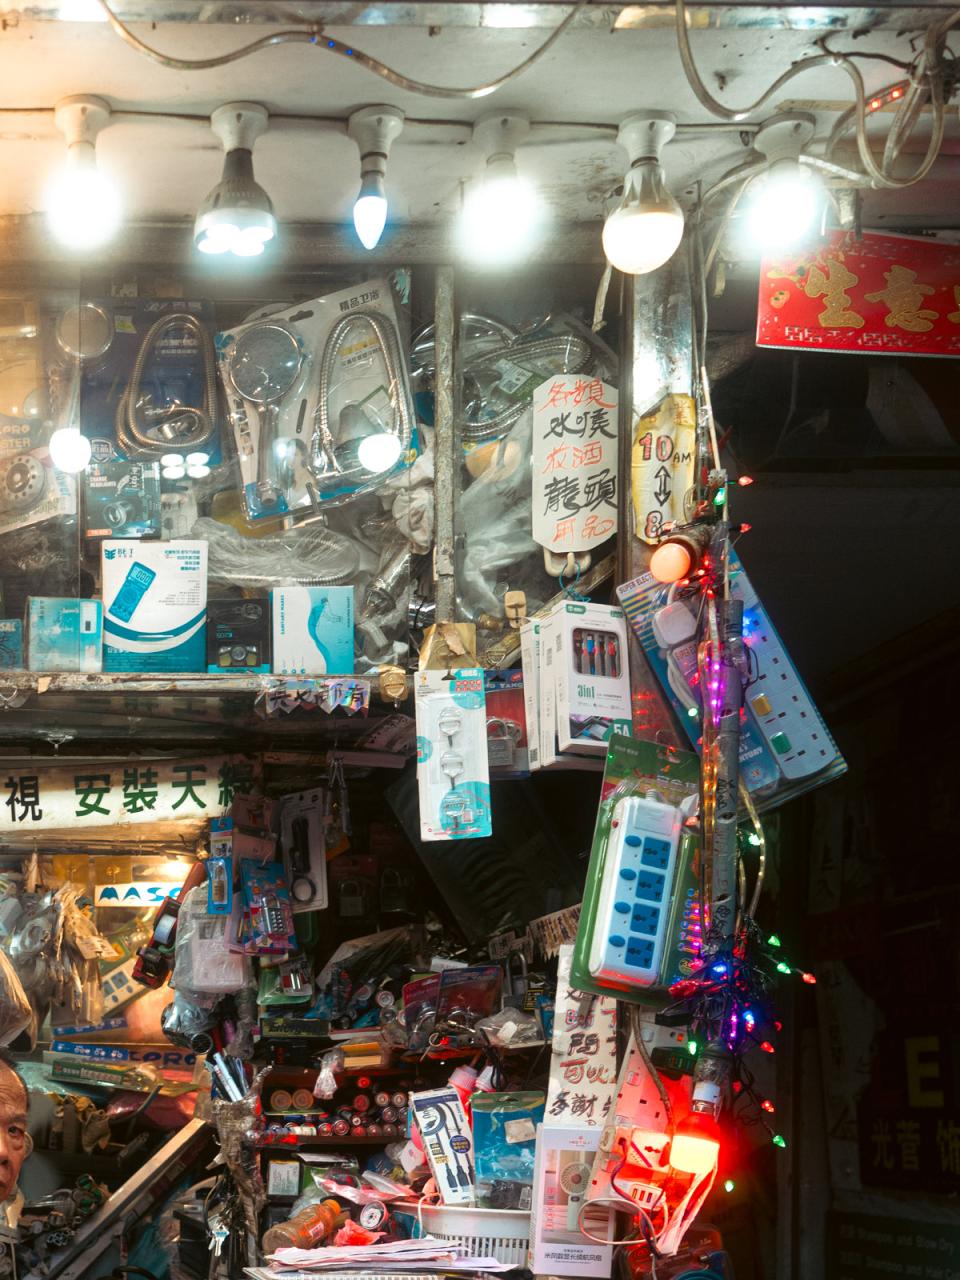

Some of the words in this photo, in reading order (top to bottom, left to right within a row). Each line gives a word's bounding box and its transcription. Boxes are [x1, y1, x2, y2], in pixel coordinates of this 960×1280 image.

[639, 432, 673, 462] 10
[673, 453, 691, 463] AM
[577, 685, 595, 698] 3in1
